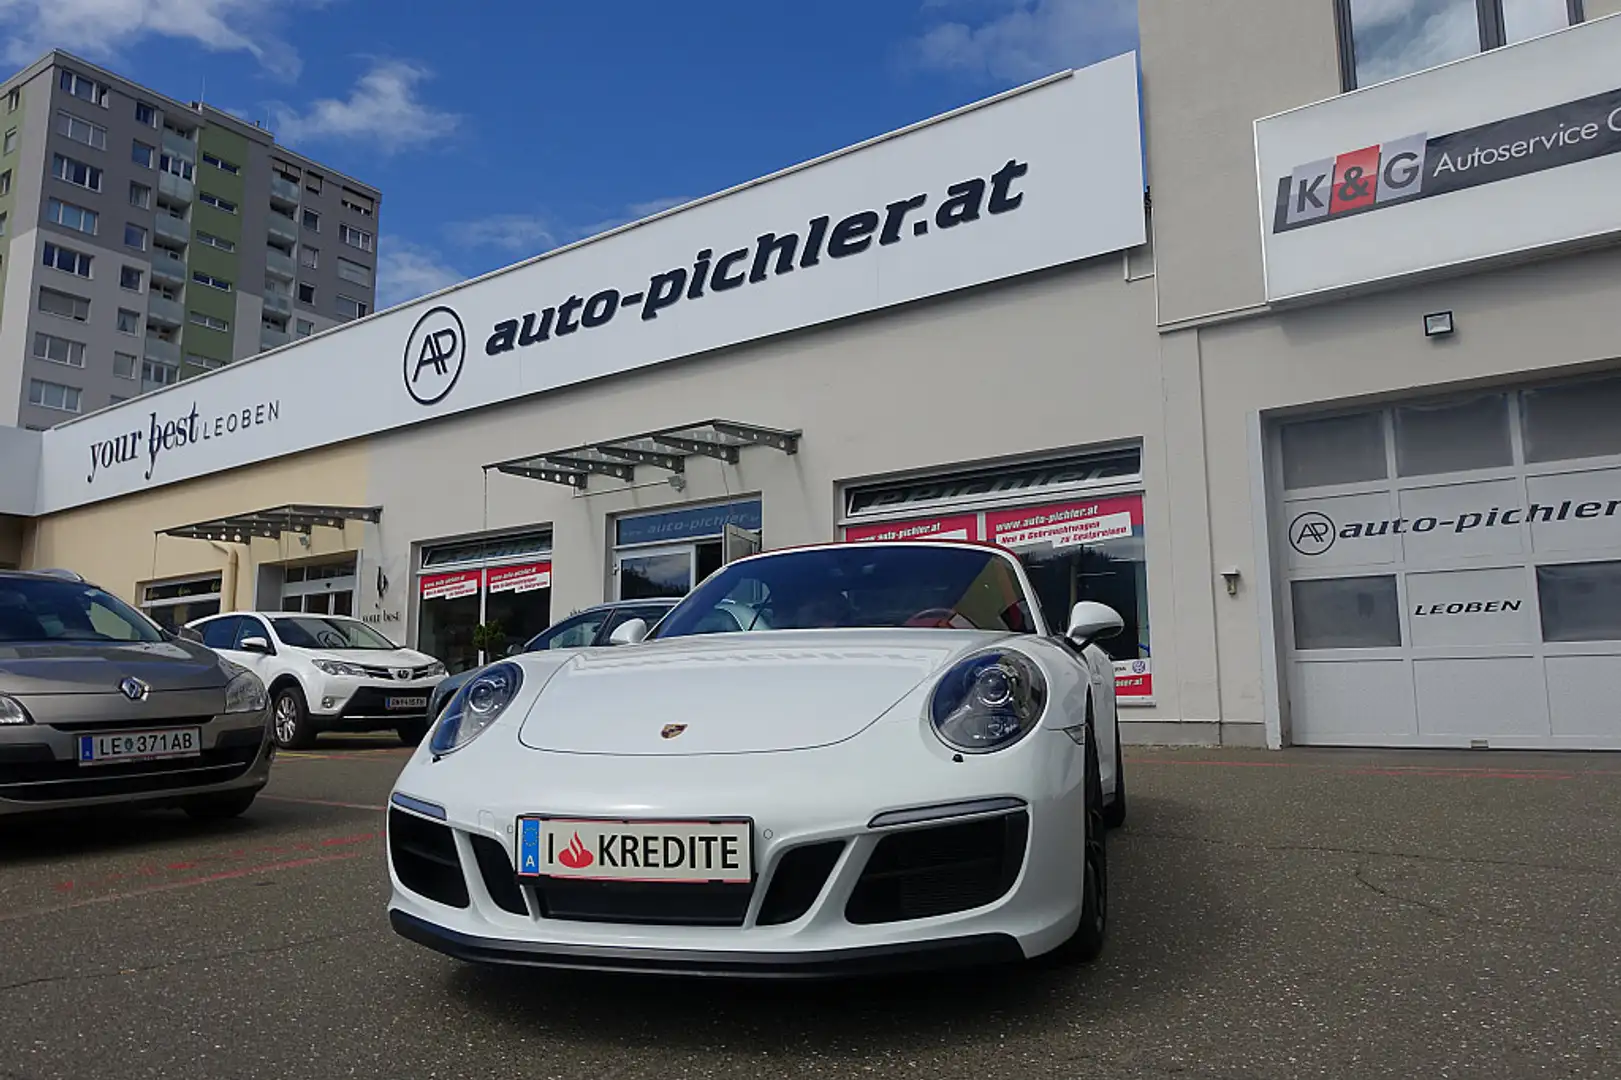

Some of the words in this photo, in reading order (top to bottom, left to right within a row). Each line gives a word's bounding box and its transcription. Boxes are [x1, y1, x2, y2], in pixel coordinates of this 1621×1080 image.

[1297, 151, 1420, 213] K&G
[1433, 123, 1598, 177] Autoservice
[485, 159, 1028, 356] auto-pichler.at
[87, 430, 142, 482] your
[145, 401, 200, 480] best
[203, 400, 280, 439] LEOBEN
[1415, 600, 1522, 616] LEOBEN
[100, 737, 122, 756] LE
[525, 855, 535, 867] A
[548, 833, 554, 864] I
[598, 834, 739, 869] KREDITE
